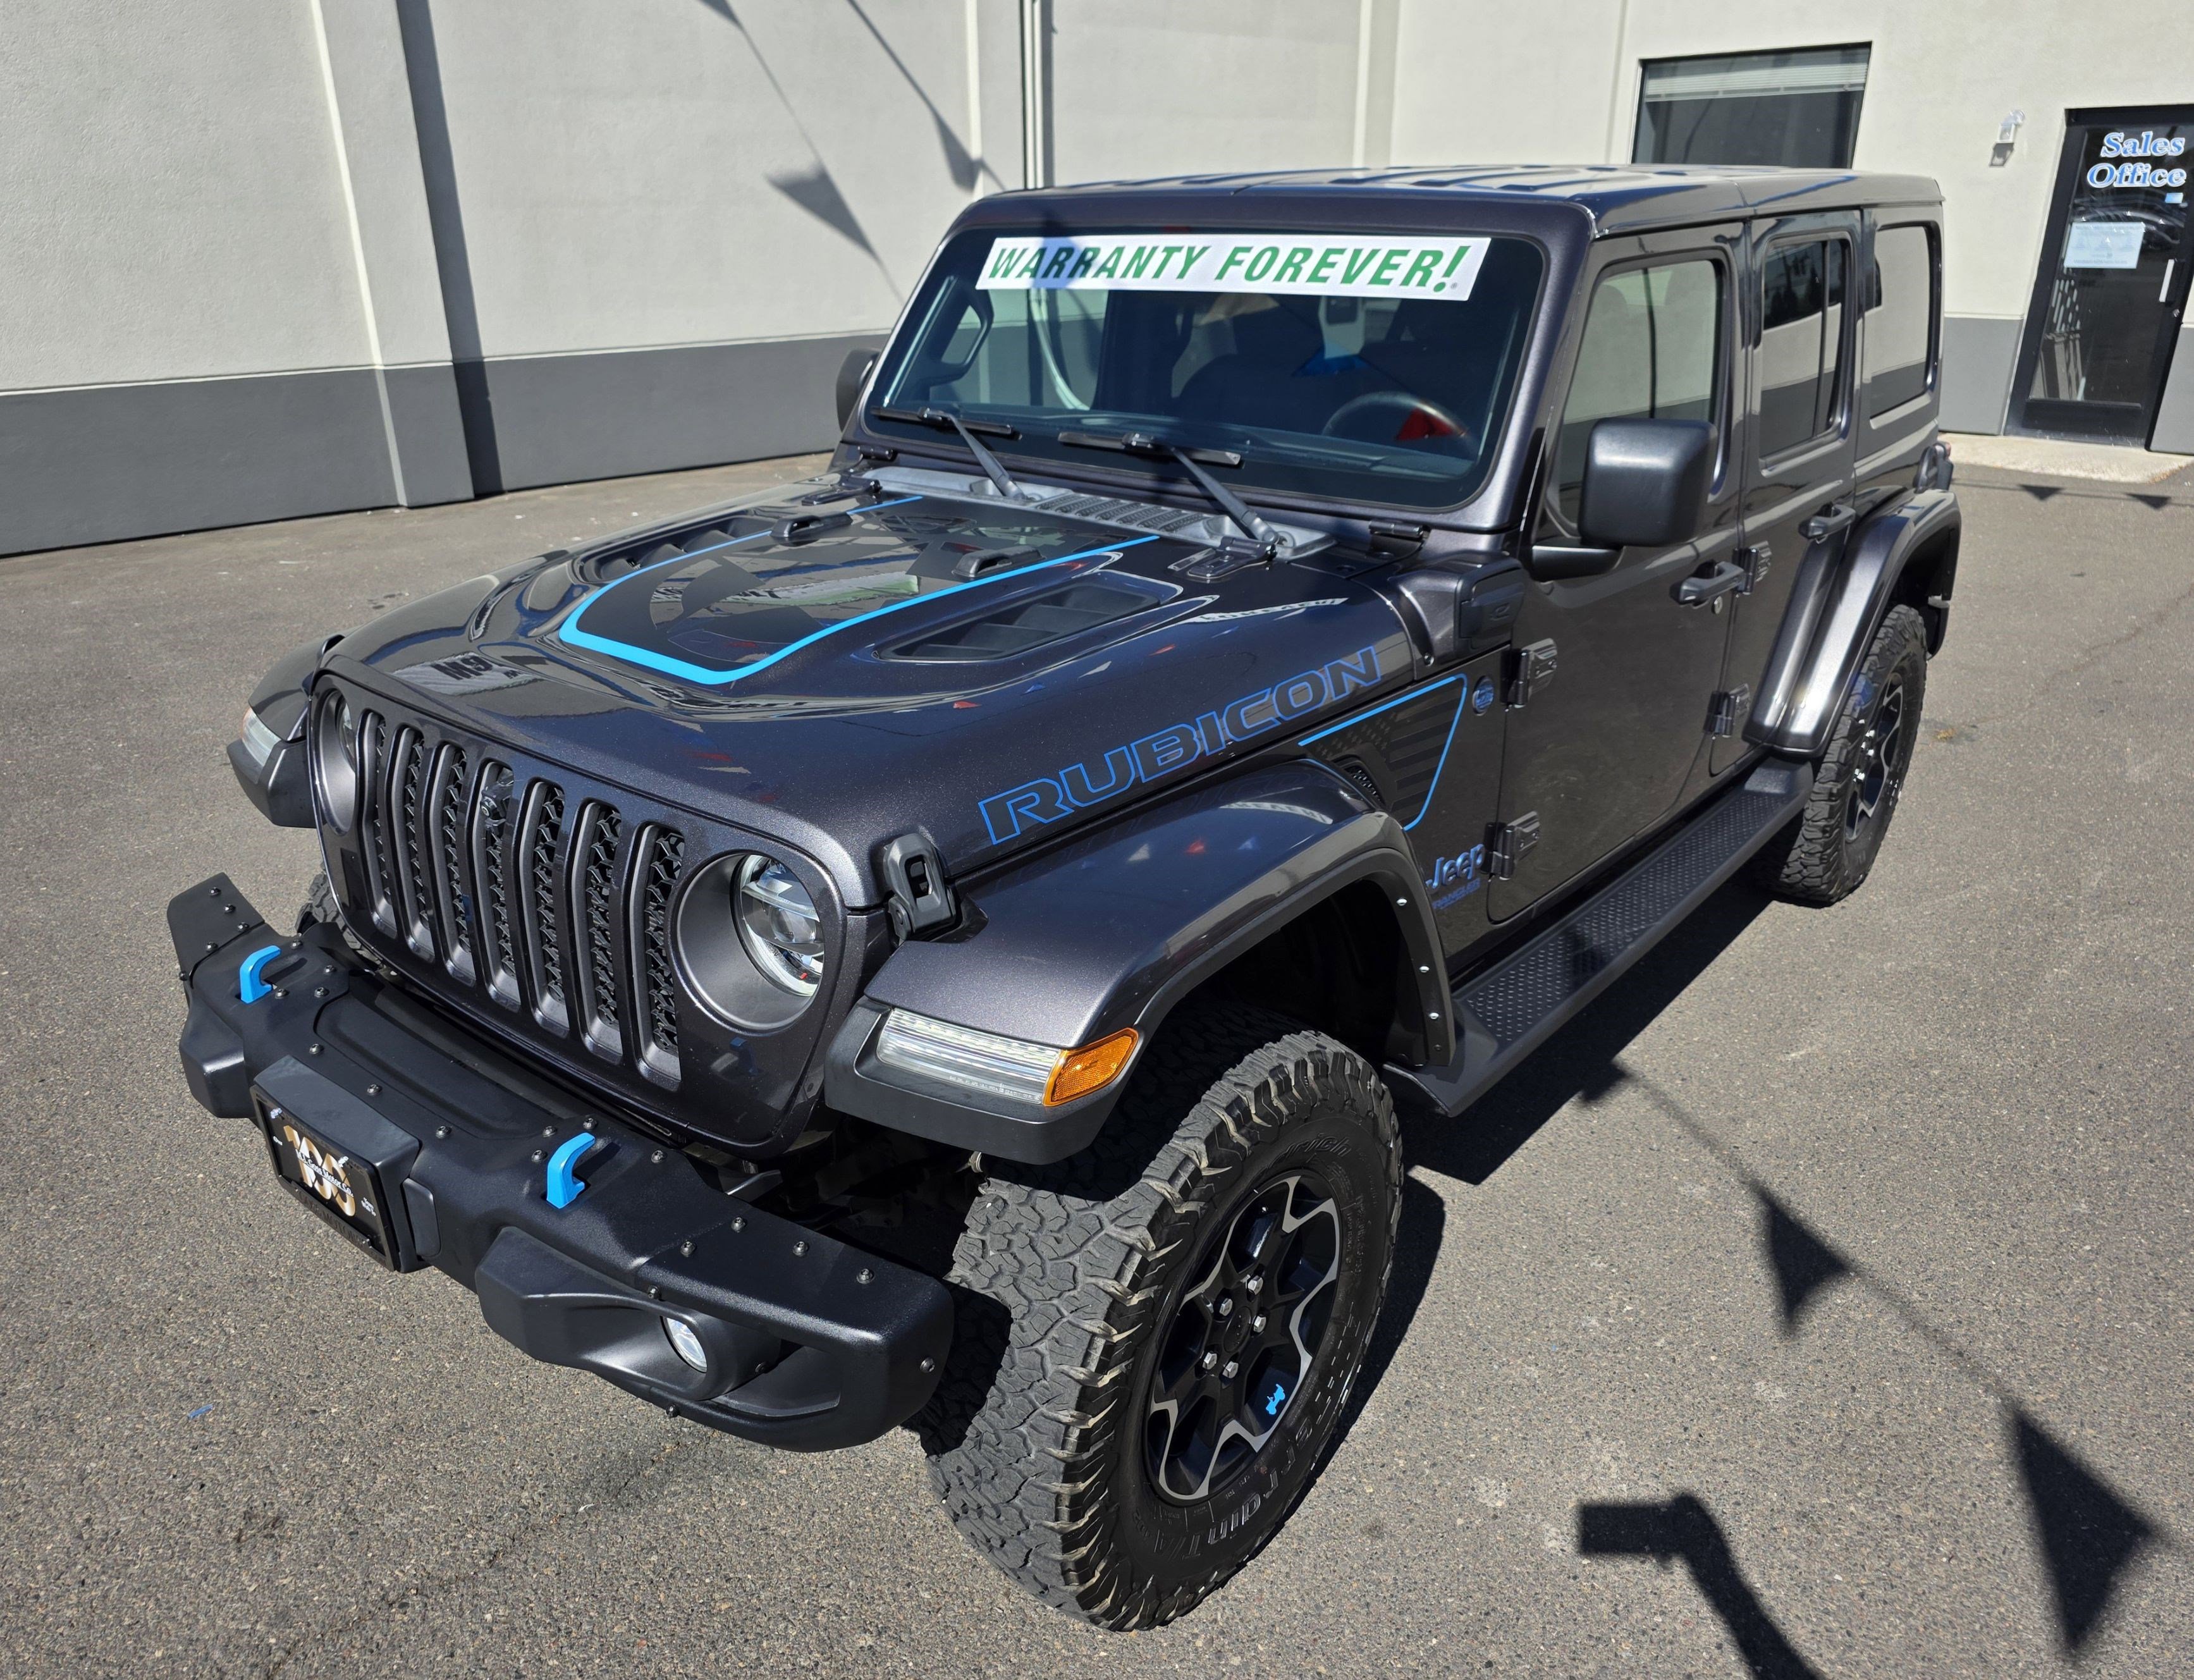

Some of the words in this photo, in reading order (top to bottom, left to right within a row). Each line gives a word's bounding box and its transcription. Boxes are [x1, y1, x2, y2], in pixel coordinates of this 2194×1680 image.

[2100, 131, 2185, 157] Sales
[2087, 162, 2186, 188] Office
[988, 245, 1211, 279] WARRANTY
[1215, 245, 1472, 292] FOREVER!
[978, 646, 1382, 845] RUBICON
[1425, 843, 1485, 894] Jeep
[1431, 878, 1481, 909] RANGLER
[283, 1125, 355, 1217] 100
